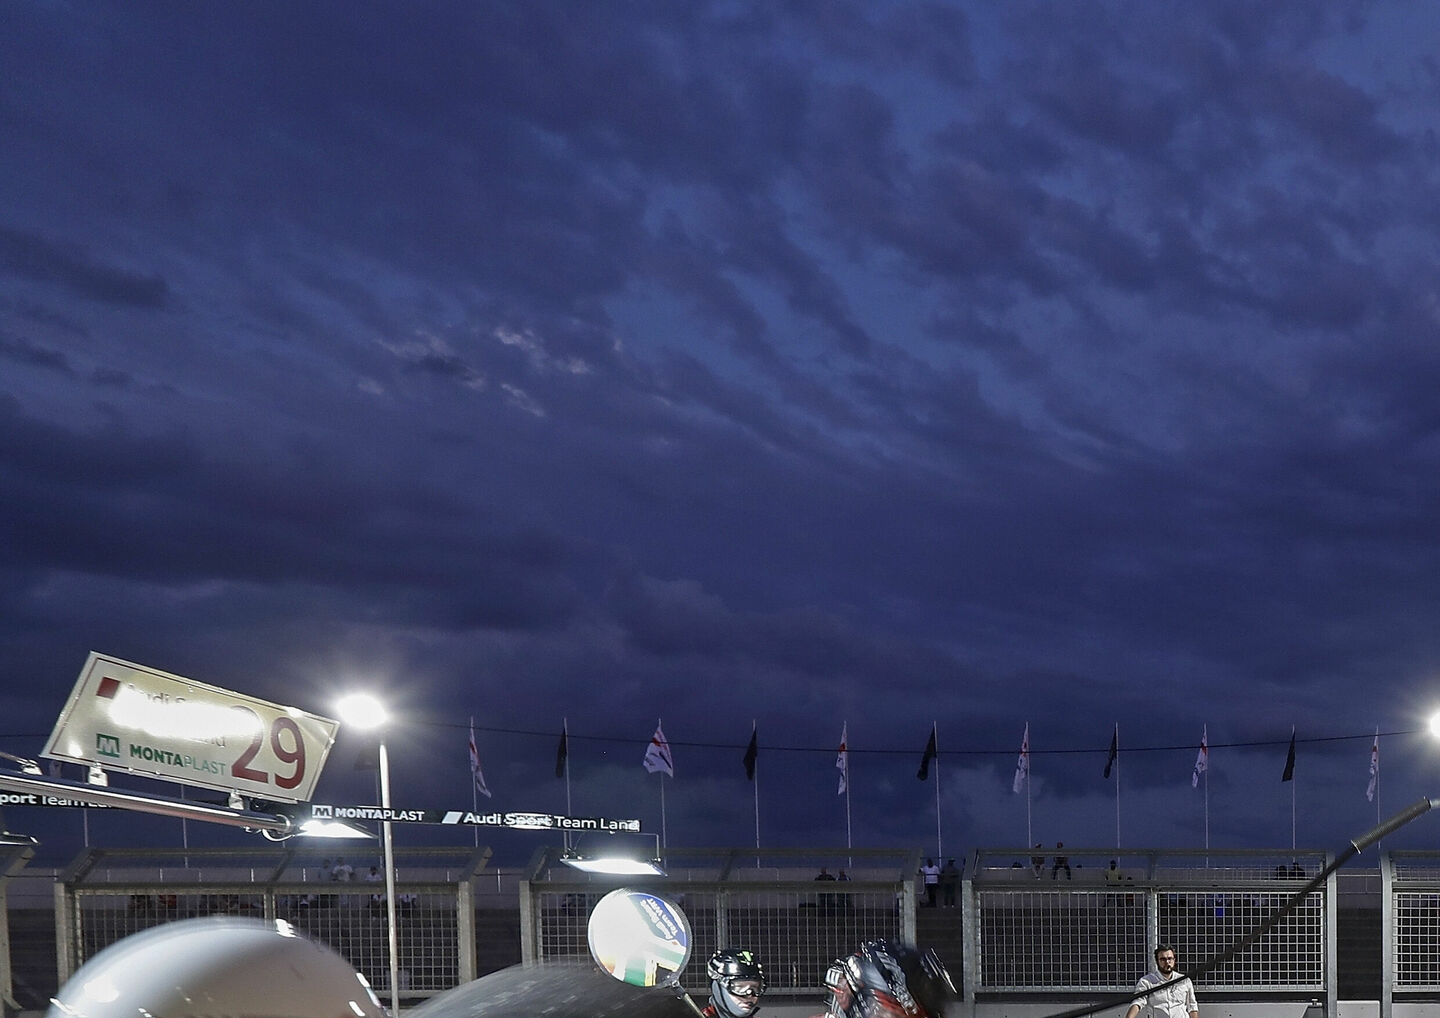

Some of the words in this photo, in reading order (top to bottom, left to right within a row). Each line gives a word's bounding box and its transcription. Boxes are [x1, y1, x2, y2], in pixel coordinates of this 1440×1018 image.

[130, 743, 226, 776] MONTAPLAST
[230, 705, 306, 790] 29
[335, 808, 425, 821] MONTAPLAST
[463, 812, 501, 825] Audi
[555, 816, 597, 829] Team
